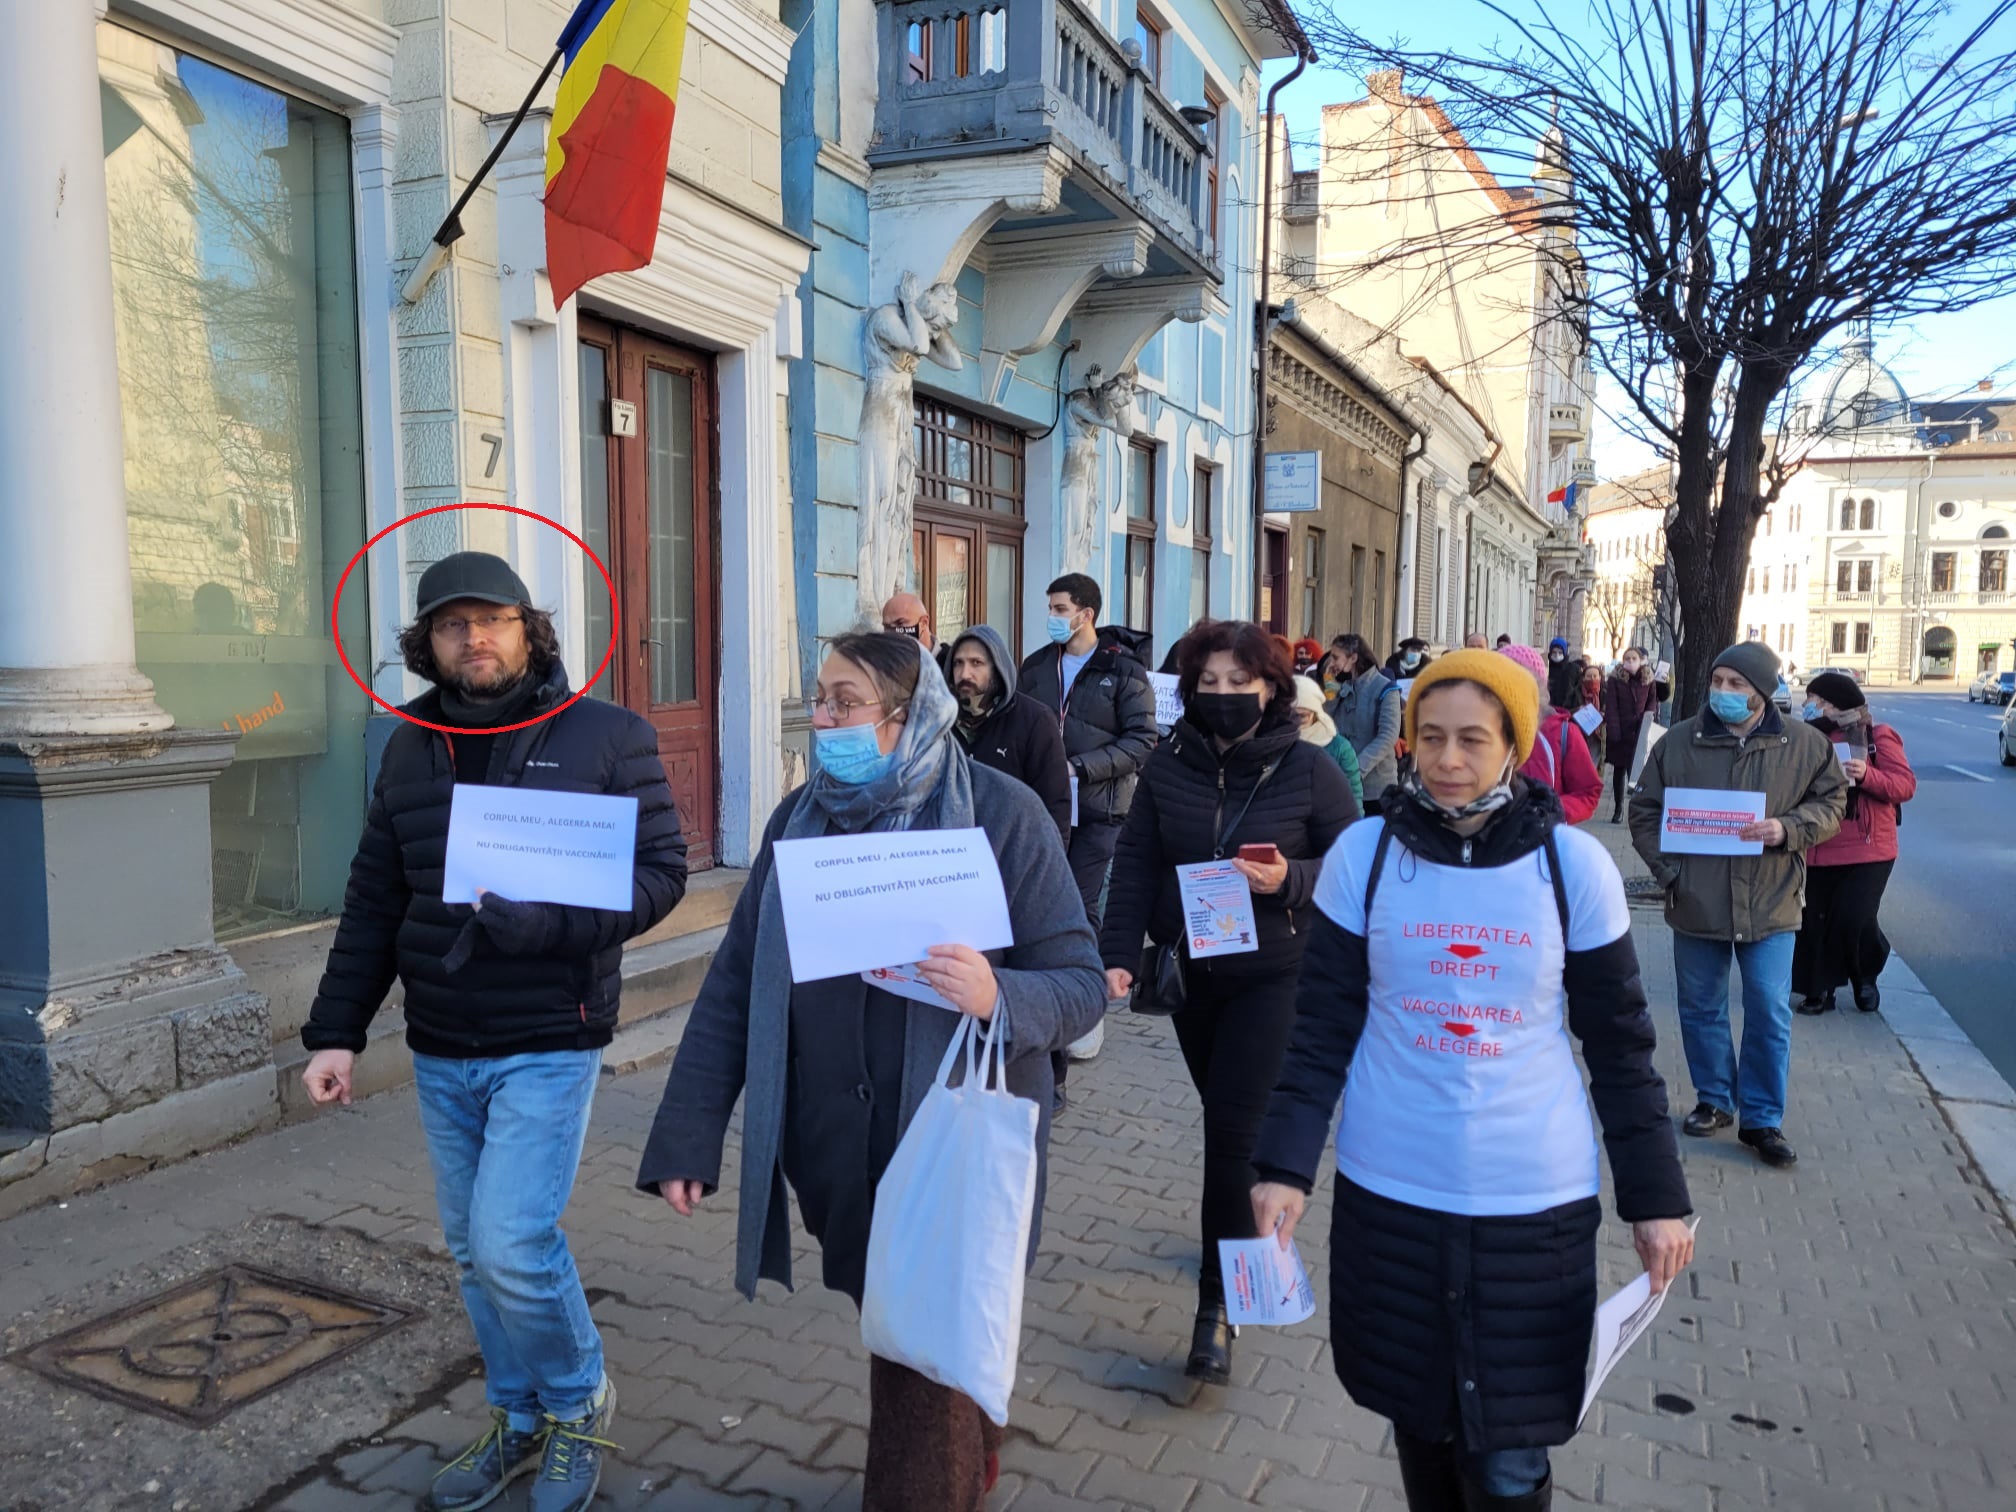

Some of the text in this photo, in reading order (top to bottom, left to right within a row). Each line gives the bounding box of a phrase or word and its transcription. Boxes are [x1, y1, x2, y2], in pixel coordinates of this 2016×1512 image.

[620, 413, 630, 431] 7
[481, 432, 503, 478] 7
[235, 690, 285, 735] hand
[483, 812, 518, 823] CORPUL
[520, 815, 540, 825] MEU
[548, 818, 591, 828] ALEGEREA
[592, 822, 615, 830] MEA!
[476, 841, 490, 849] NU
[814, 857, 855, 868] CORPUL
[857, 854, 881, 864] MEU
[889, 849, 939, 859] ALEGEREA
[941, 847, 968, 855] MEA!
[815, 892, 831, 902] NU
[918, 871, 979, 887] VACCINĂRII!
[1403, 922, 1533, 947] LIBERTATEA
[1430, 960, 1501, 980] DREPT
[1402, 997, 1523, 1024] VACCINAREA
[1415, 1034, 1504, 1057] ALEGERE
